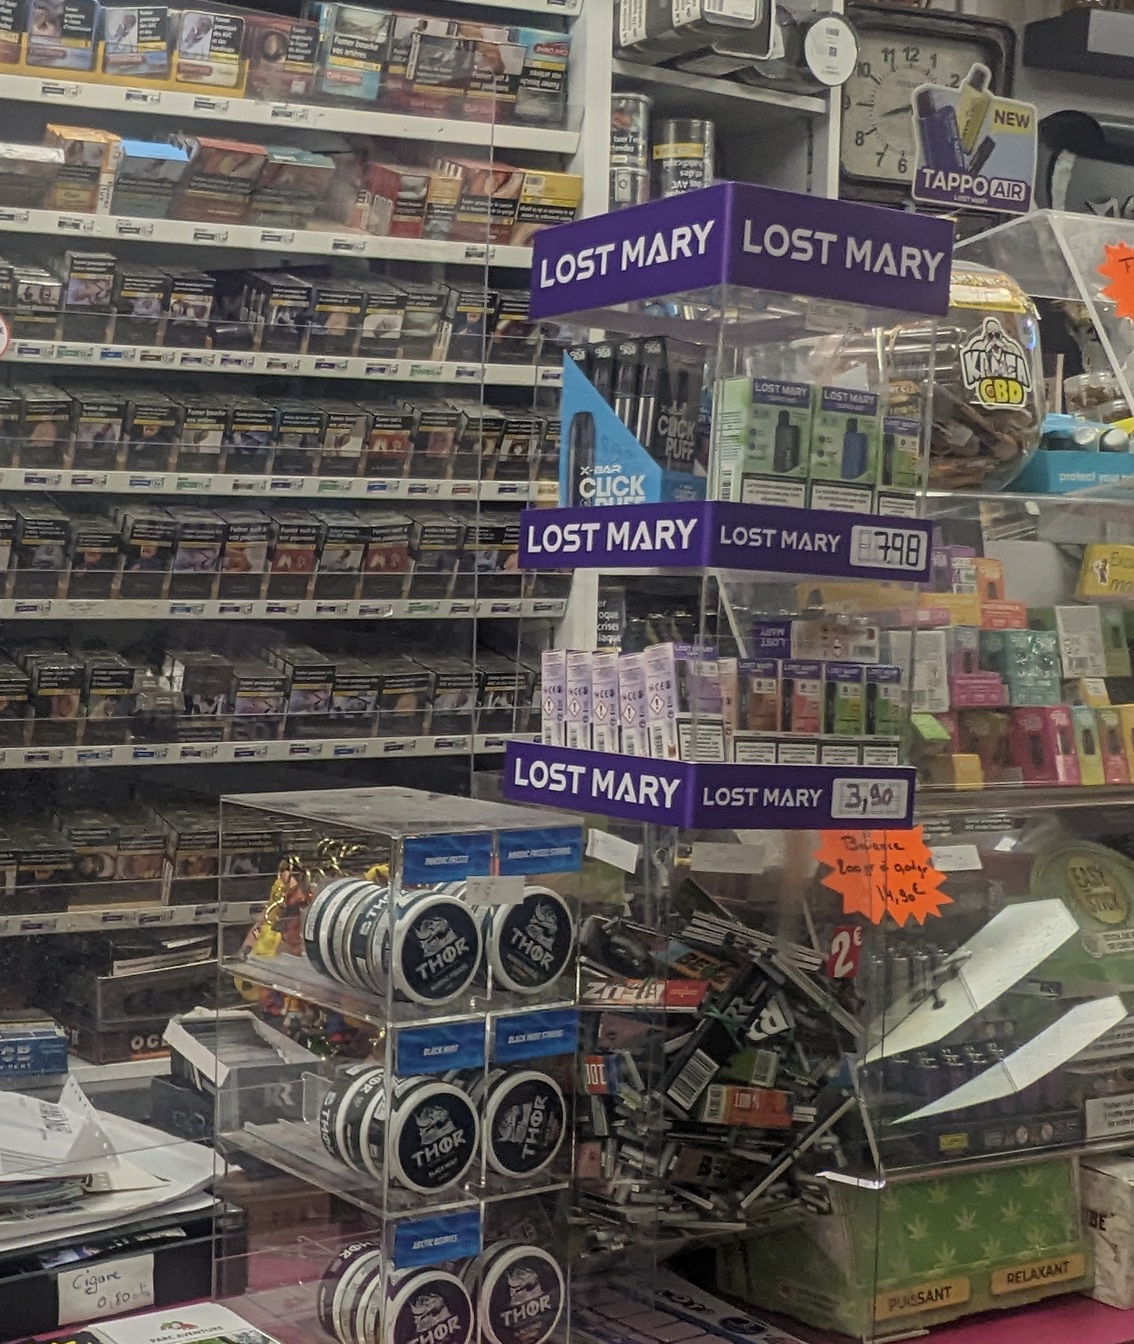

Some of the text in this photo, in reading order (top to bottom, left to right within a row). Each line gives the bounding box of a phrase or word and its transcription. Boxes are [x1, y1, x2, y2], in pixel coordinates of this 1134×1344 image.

[903, 46, 919, 63] 12
[930, 54, 937, 68] 1
[857, 62, 961, 88] 10 2
[993, 109, 1030, 130] NEW
[855, 131, 865, 147] 8
[875, 152, 908, 174] 7 6
[922, 168, 1024, 200] TAPPO AIR
[540, 219, 714, 288] LOST MARY
[742, 220, 944, 282] LOST MARY
[753, 383, 810, 399] LOST MARY
[823, 389, 875, 405] LOST MARY
[979, 379, 1025, 406] CBD
[663, 438, 695, 462] PUFF
[579, 462, 622, 476] X-BAR
[1059, 471, 1096, 482] protect
[579, 475, 645, 500] CLICK
[527, 517, 698, 553] LOST MARY
[719, 527, 842, 553] LOST MARY
[514, 755, 681, 808] LOST MARY
[702, 785, 823, 808] LOST MARY
[1069, 866, 1108, 895] EASY
[415, 936, 471, 977] THOR
[510, 927, 556, 971] THOR
[521, 1095, 547, 1160] THOR
[412, 1130, 466, 1166] THOR
[72, 1269, 123, 1296] Cigare
[1006, 1261, 1071, 1285] RELAXANT
[500, 1293, 551, 1326] THOR
[887, 1285, 953, 1312] PUISSANT
[150, 1325, 224, 1344] PARC AVENTURE
